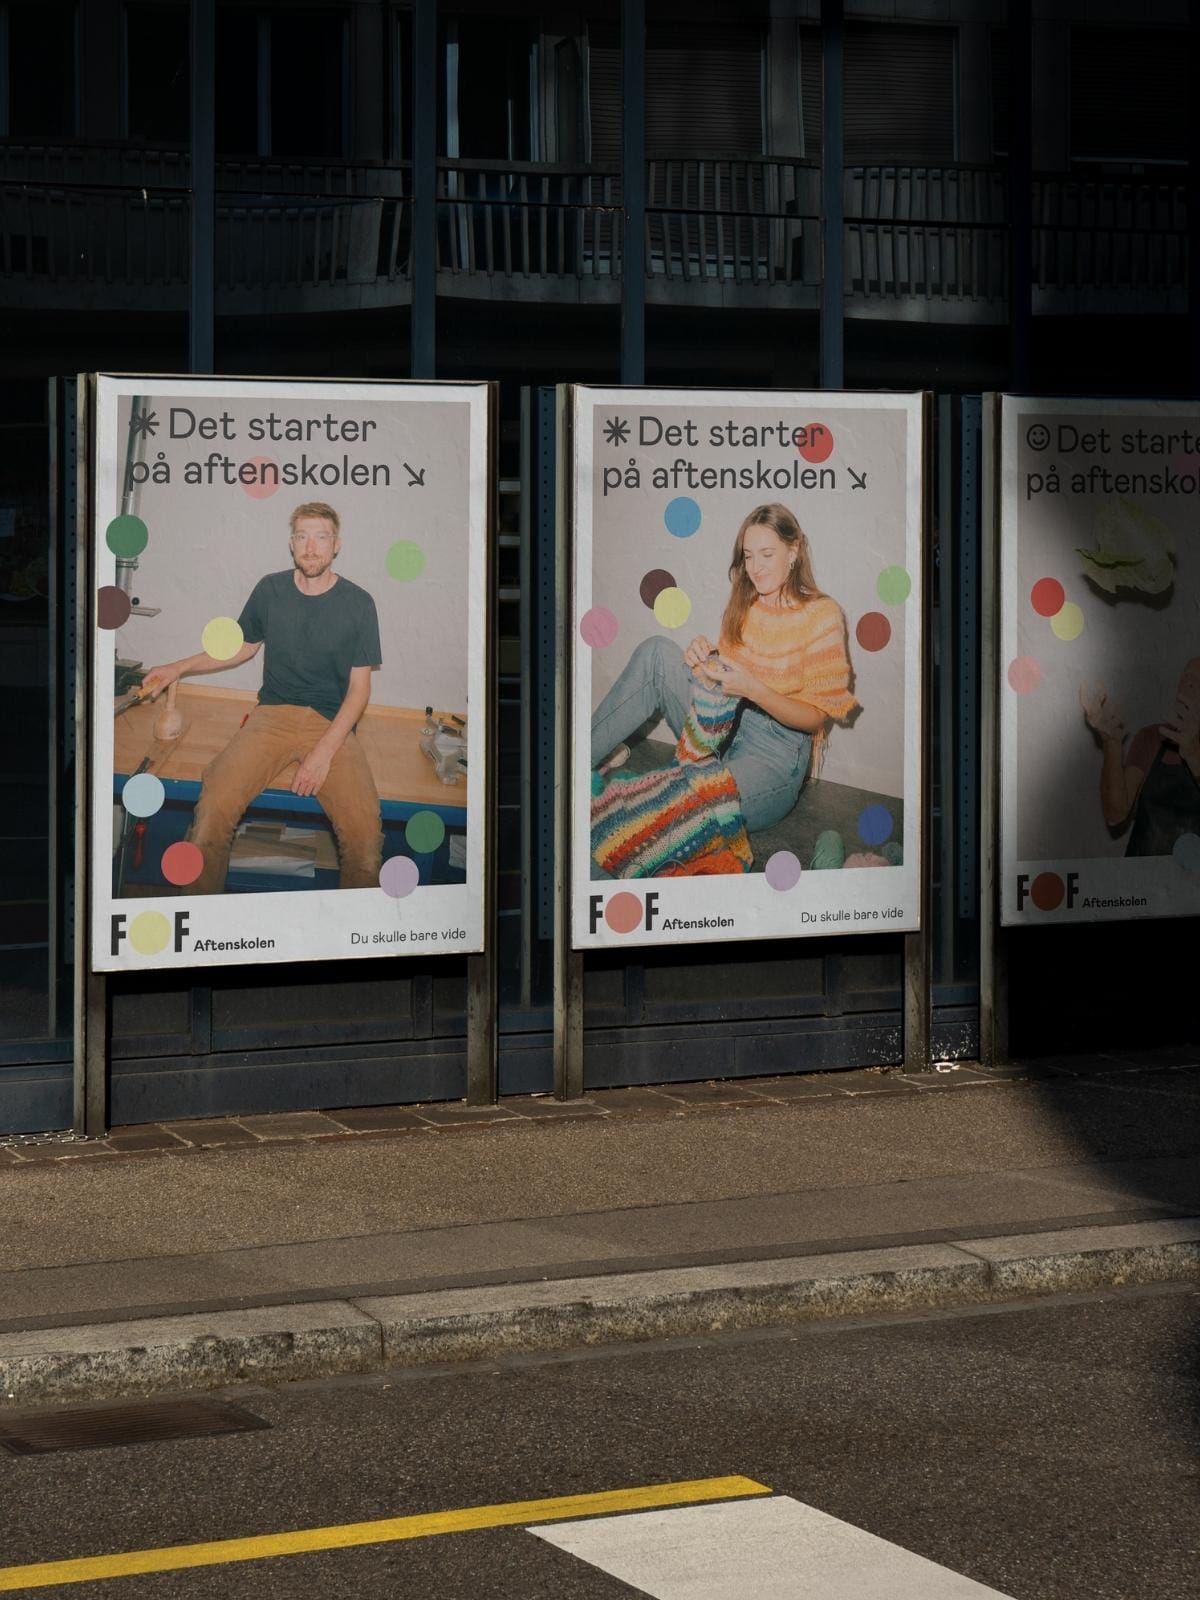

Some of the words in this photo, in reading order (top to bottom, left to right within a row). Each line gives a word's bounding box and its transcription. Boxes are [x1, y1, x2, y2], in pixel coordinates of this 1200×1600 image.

[169, 407, 237, 440] Det
[248, 412, 377, 442] starter
[638, 416, 699, 447] Det
[709, 419, 824, 448] starter
[1057, 425, 1111, 454] Det
[1121, 429, 1200, 454] start
[129, 452, 171, 492] på
[184, 452, 391, 486] aftenskolen
[603, 458, 641, 496] på
[652, 458, 836, 490] aftenskolen
[1027, 464, 1060, 500] på
[1071, 465, 1200, 494] aftensko
[801, 912, 818, 923] Du
[820, 909, 851, 922] skulle
[853, 908, 879, 921] bare
[881, 907, 904, 919] vide
[1082, 896, 1147, 909] Aftenskolen
[351, 932, 370, 945] Du
[372, 930, 407, 943] skulle
[410, 928, 439, 942] bare
[441, 927, 467, 940] vide
[662, 916, 735, 931] Aftenskolen
[193, 937, 276, 952] Aftenskolen
